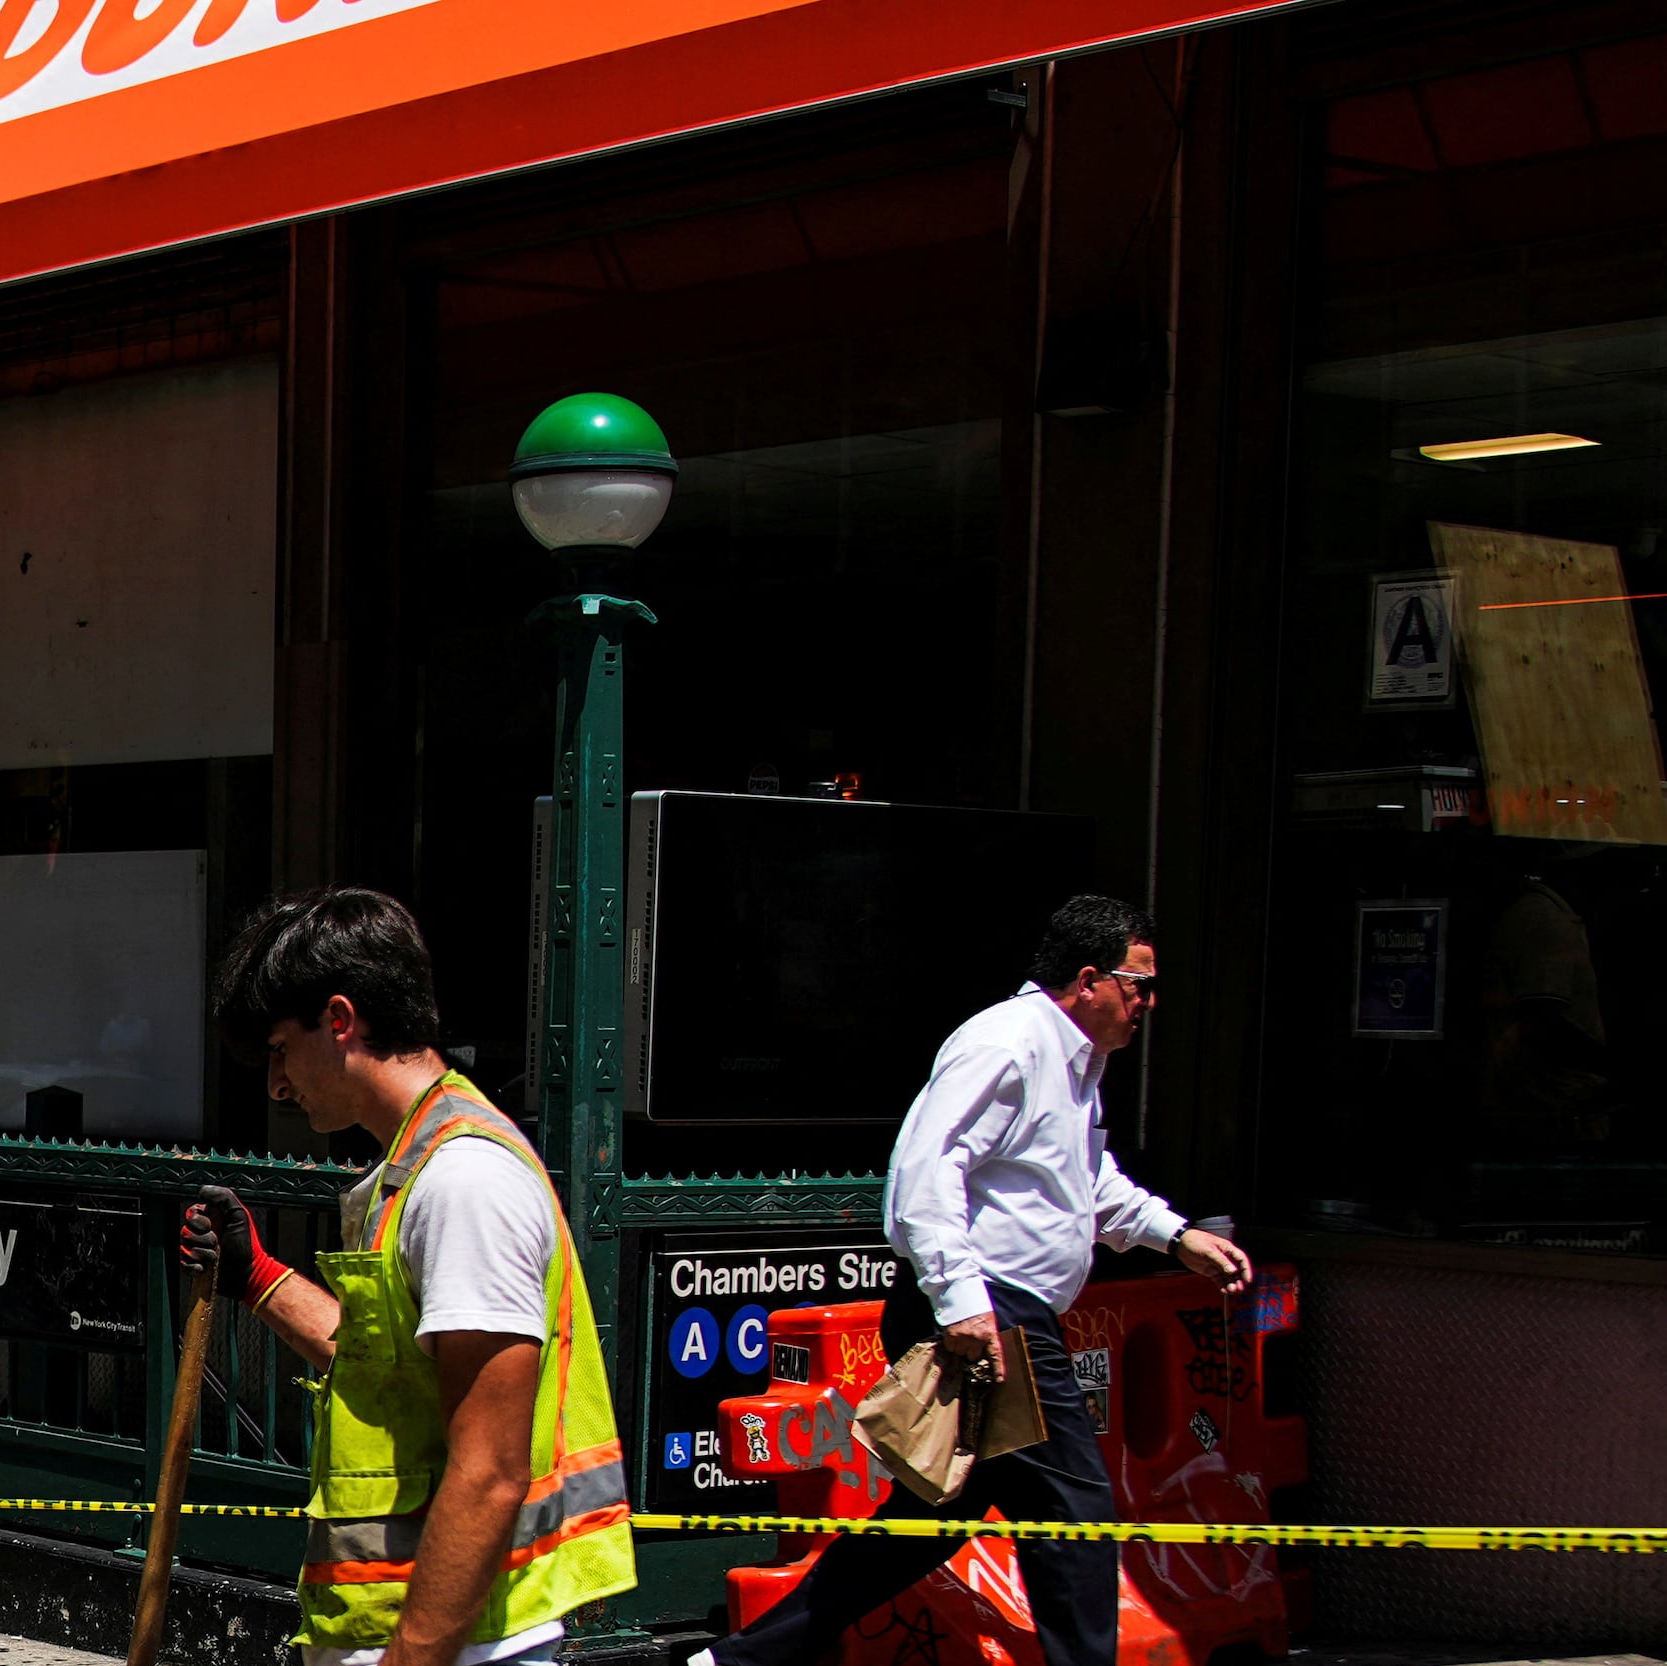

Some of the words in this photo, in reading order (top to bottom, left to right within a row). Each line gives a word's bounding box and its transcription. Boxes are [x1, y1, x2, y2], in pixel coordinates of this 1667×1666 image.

[1385, 596, 1437, 665] A
[670, 1256, 825, 1298] Chambers
[838, 1252, 898, 1291] Stre
[681, 1321, 708, 1362] A
[737, 1317, 764, 1359] C
